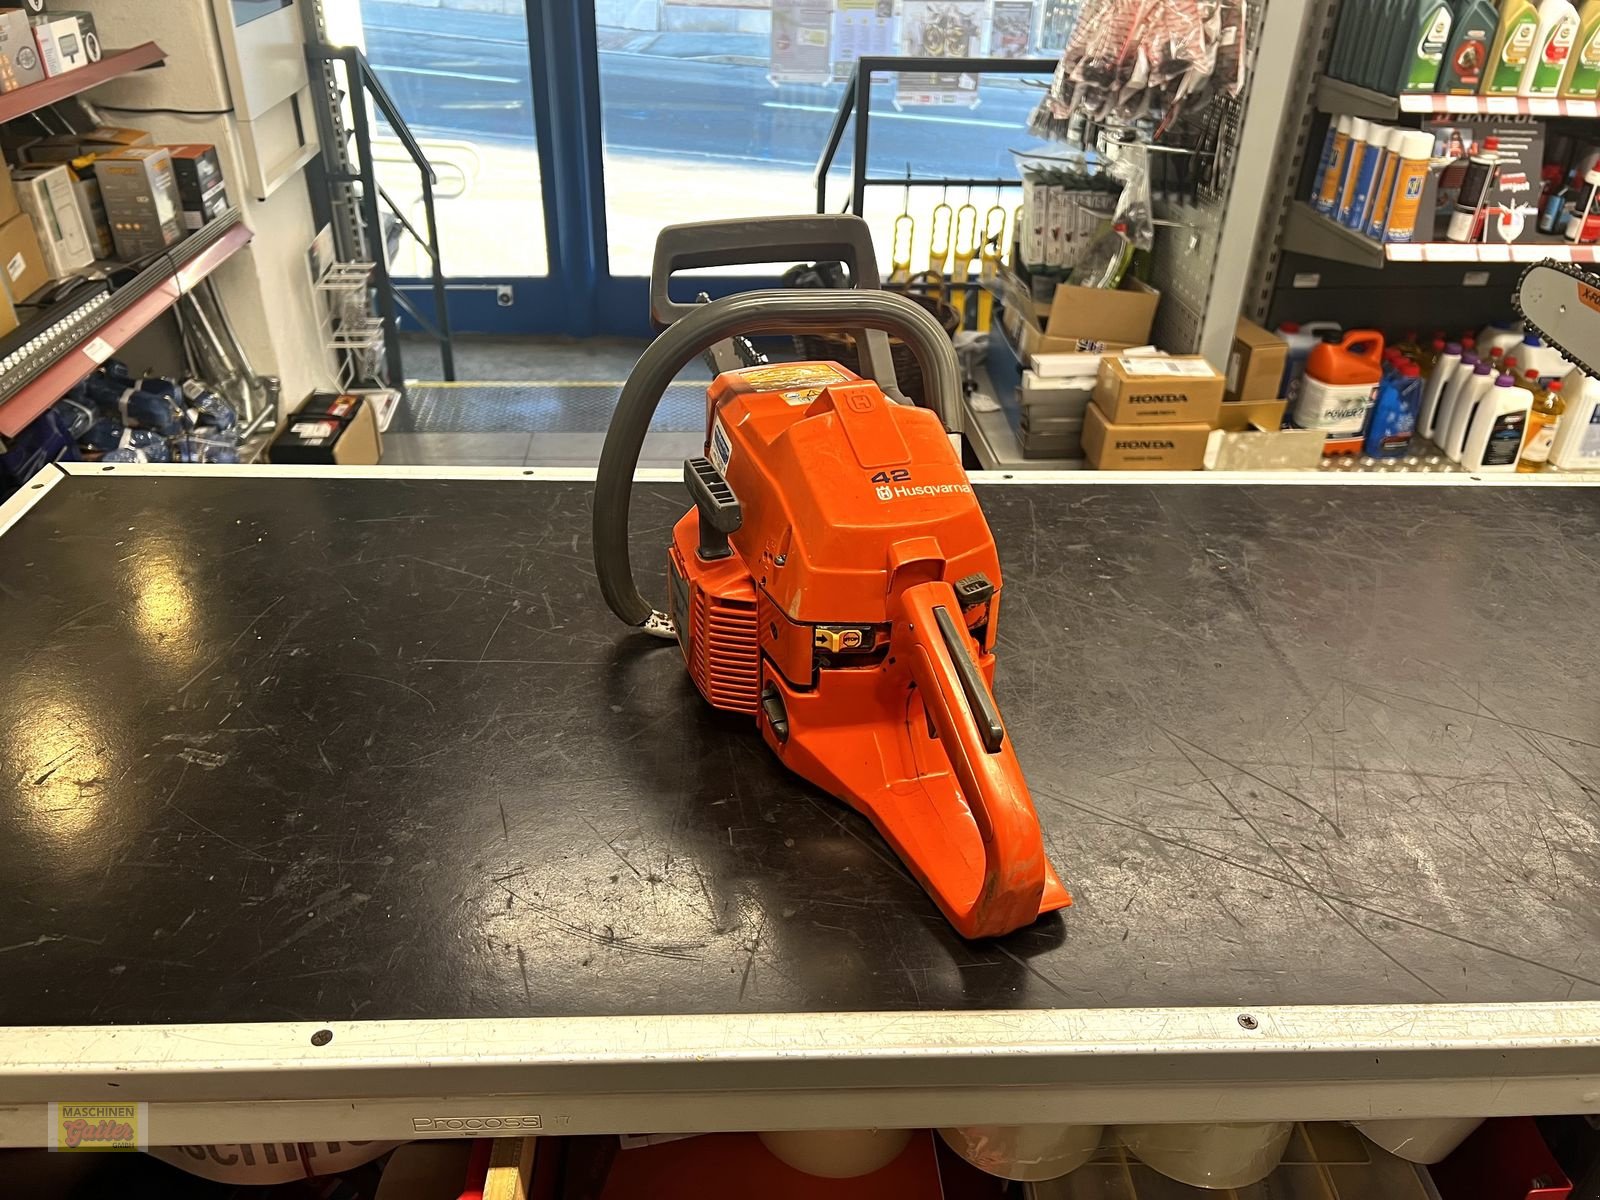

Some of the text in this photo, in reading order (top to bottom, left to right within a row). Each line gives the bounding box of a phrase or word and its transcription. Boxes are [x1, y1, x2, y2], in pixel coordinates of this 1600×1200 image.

[1128, 393, 1188, 404] HONDA
[1115, 440, 1174, 450] HONDA
[871, 469, 911, 483] 42
[894, 483, 971, 498] Husqvarna
